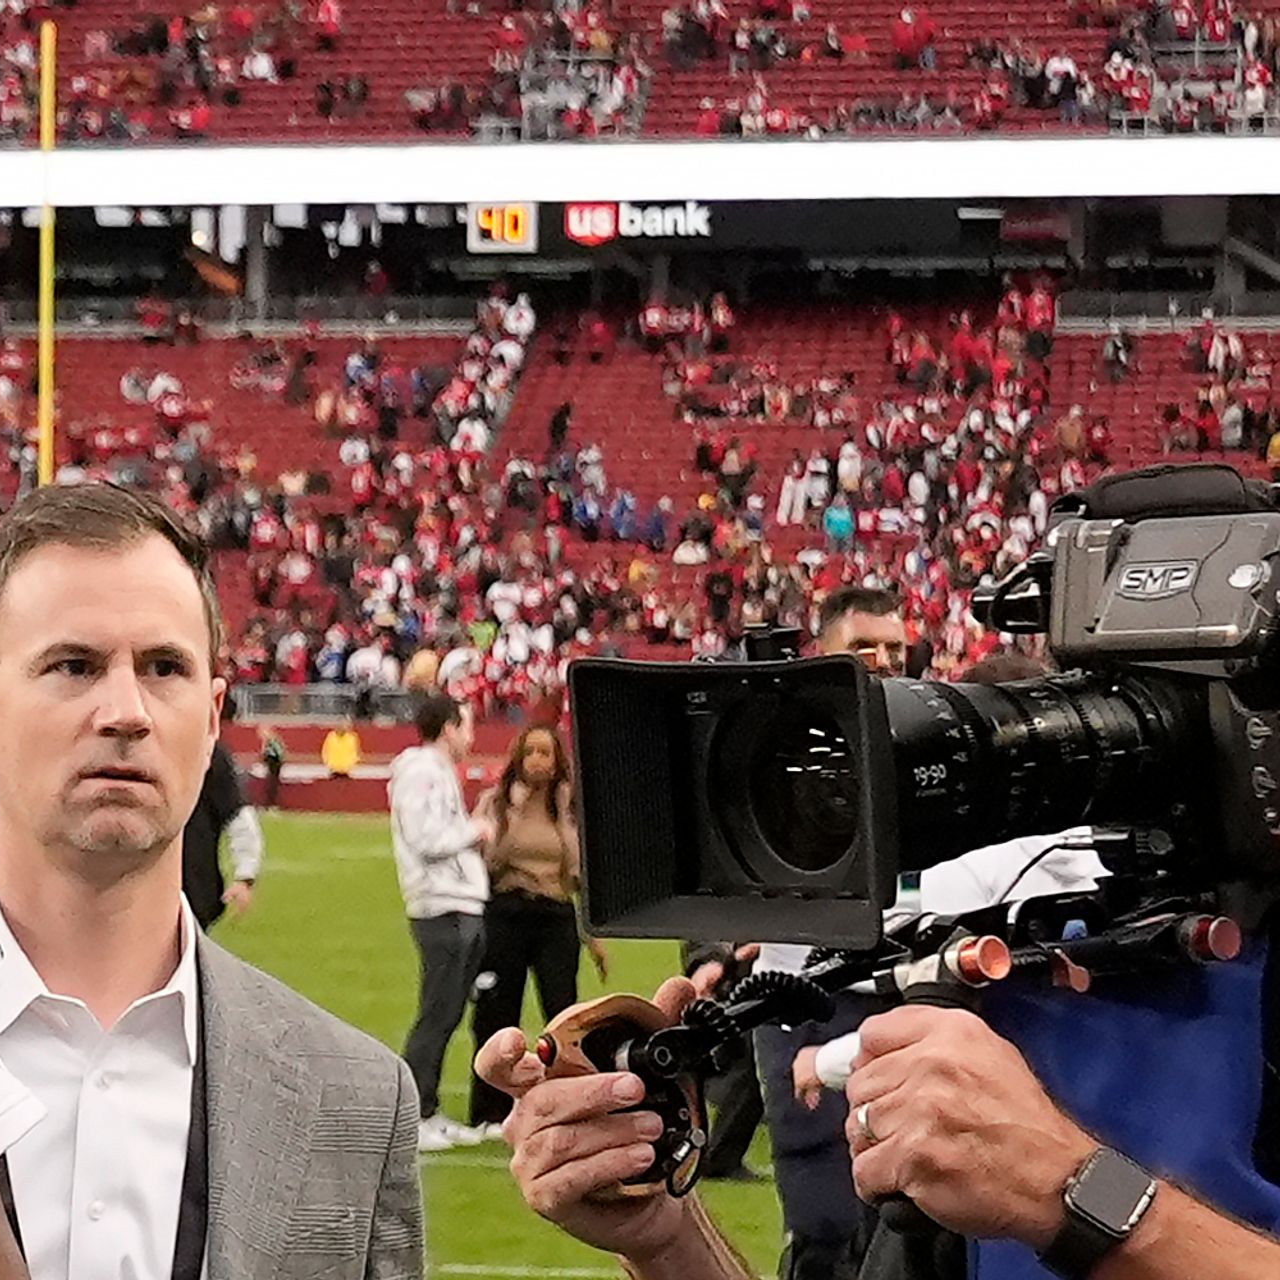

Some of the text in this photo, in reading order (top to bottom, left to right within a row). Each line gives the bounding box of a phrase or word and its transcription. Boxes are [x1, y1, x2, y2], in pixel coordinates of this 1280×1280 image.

[477, 207, 528, 244] 40
[618, 200, 710, 237] bank
[1124, 567, 1189, 590] SMP
